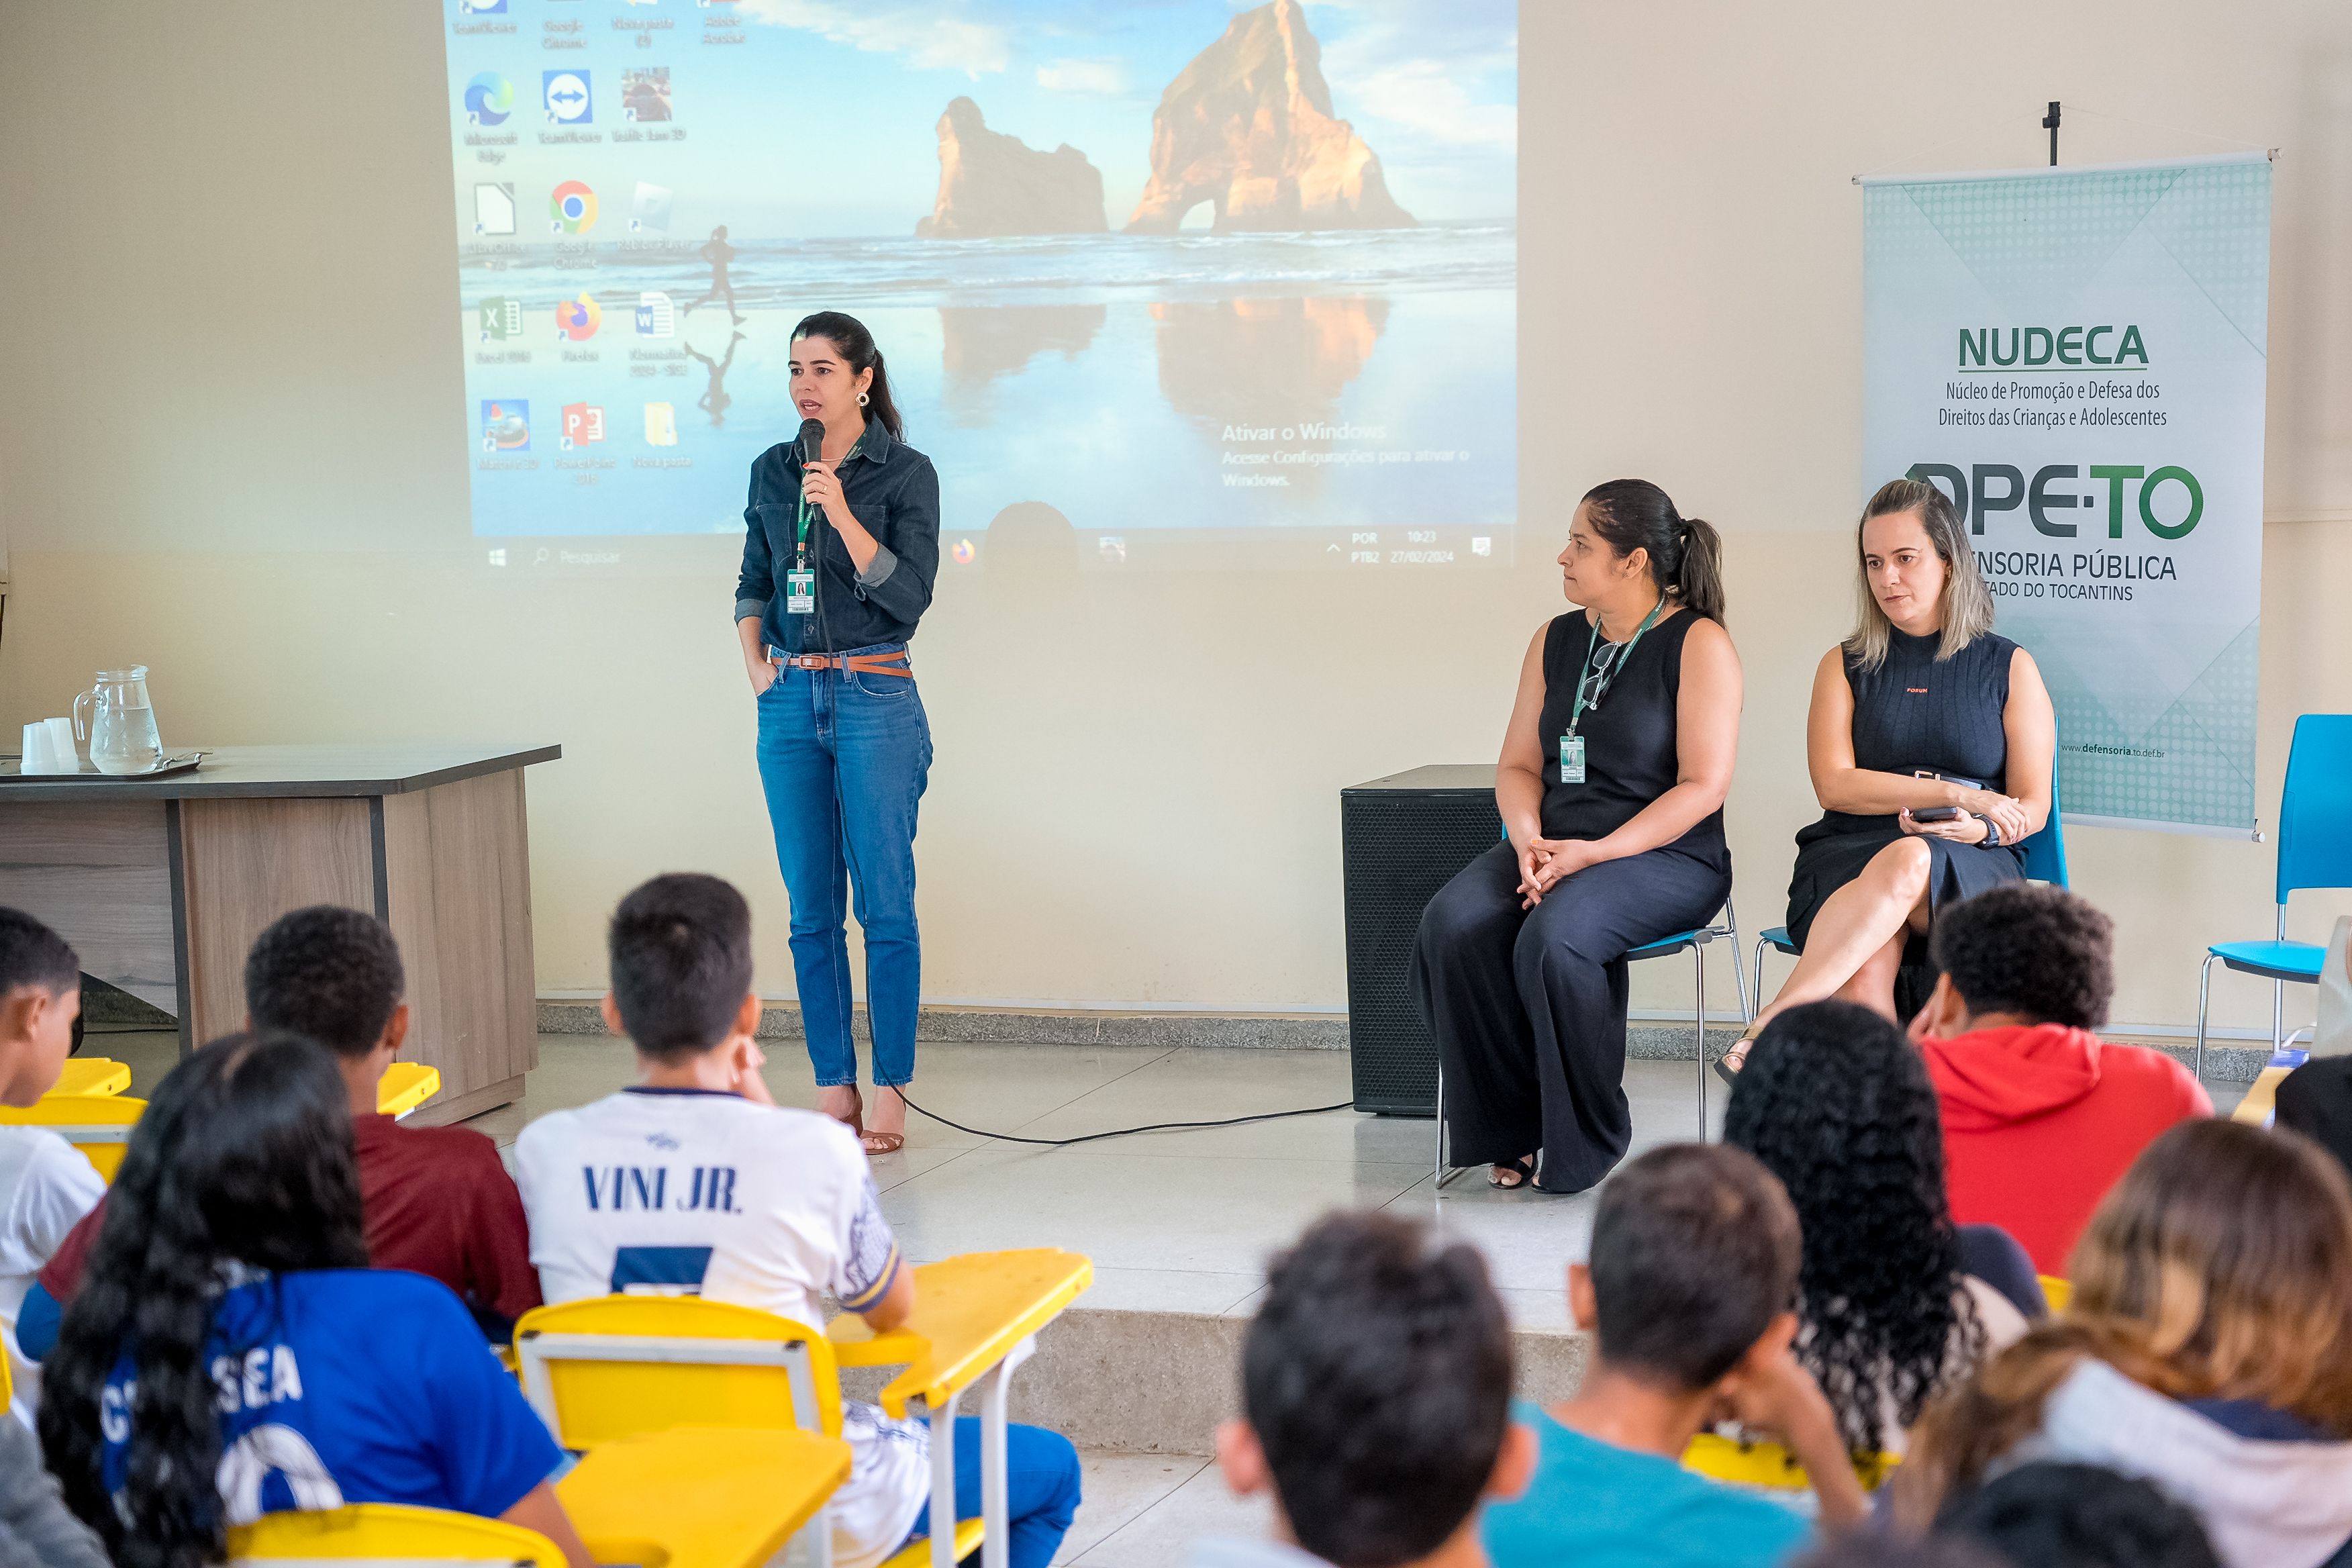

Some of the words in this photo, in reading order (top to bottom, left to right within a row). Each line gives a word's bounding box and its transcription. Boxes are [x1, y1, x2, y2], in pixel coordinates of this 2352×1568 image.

[1958, 325, 2150, 367] NUDECA
[1947, 381, 1988, 399] Núcleo
[1992, 381, 2007, 399] de
[2010, 381, 2074, 403] Promoção
[2077, 385, 2085, 399] e
[2089, 380, 2132, 399] Defesa
[2137, 379, 2160, 399] dos
[1939, 408, 1985, 426] Direitos
[1989, 407, 2010, 426] das
[2013, 407, 2065, 430] Crianças
[2069, 412, 2077, 426] e
[2080, 407, 2167, 426] Adolescentes
[1222, 424, 1275, 441] Ativar
[1281, 428, 1294, 440] o
[1300, 423, 1387, 440] Windows
[1222, 451, 1269, 465] Acesse
[1273, 449, 1374, 468] Configurações
[1379, 452, 1410, 464] para
[1352, 532, 1378, 544] POR
[2073, 548, 2177, 581] PÚBLICA
[2024, 583, 2045, 598] DO
[2049, 583, 2133, 601] TOCANTINS
[2061, 743, 2165, 758] www.defensoria.to.def.br
[581, 1165, 668, 1212] VINI
[675, 1165, 744, 1216] JR.
